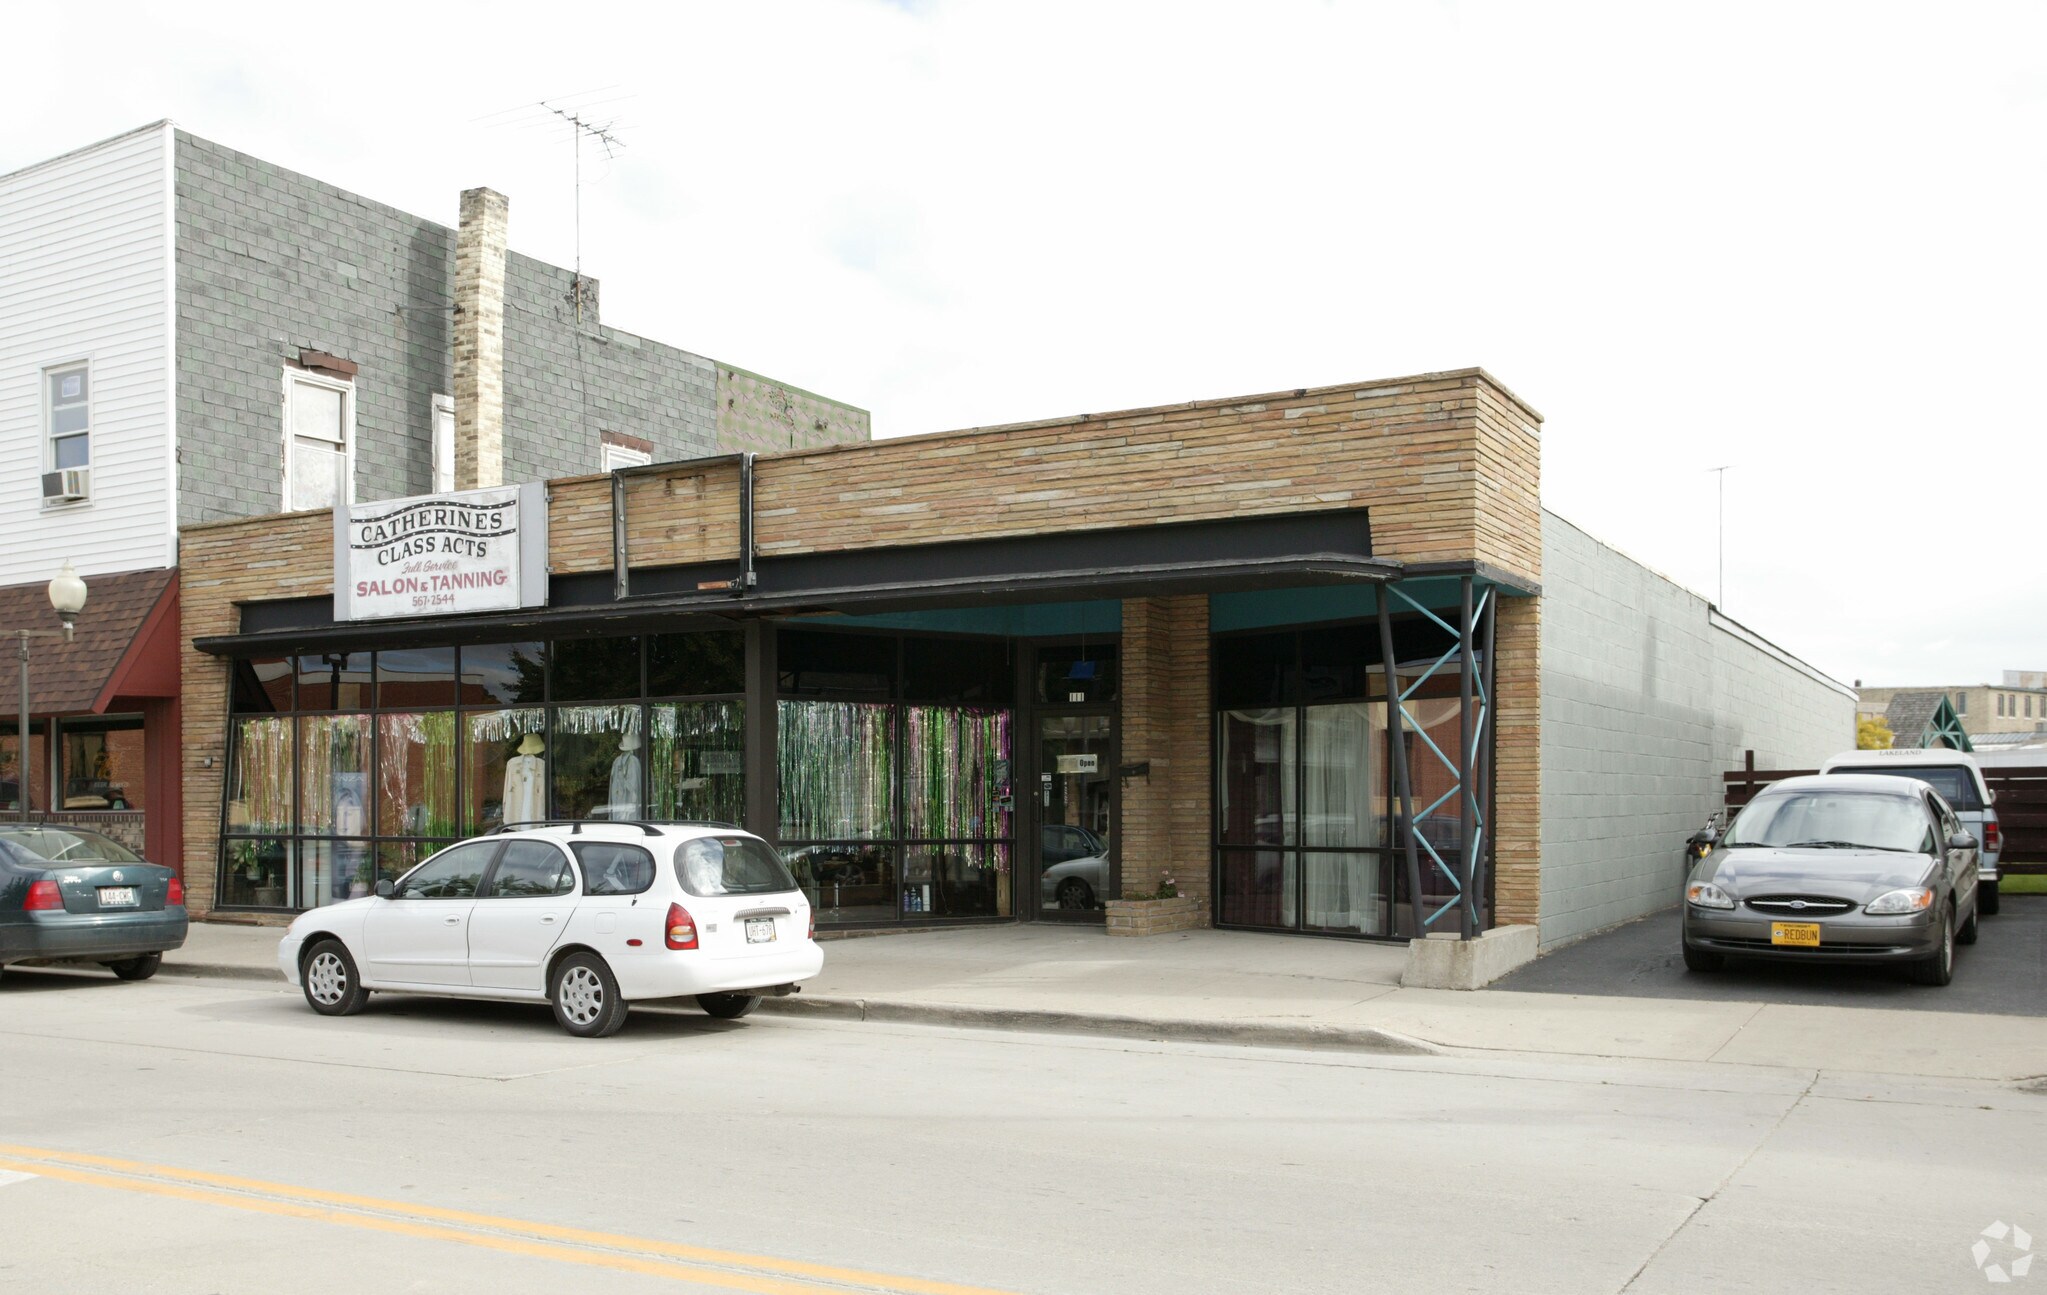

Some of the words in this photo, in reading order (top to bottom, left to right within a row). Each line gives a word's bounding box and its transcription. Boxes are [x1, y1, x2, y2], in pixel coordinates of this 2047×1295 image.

[361, 508, 503, 543] CATHERINES
[377, 536, 436, 566] CLASS
[441, 536, 487, 558] ACTS
[401, 560, 422, 575] Full
[423, 560, 458, 573] Service
[356, 577, 419, 598] SALON
[420, 581, 429, 592] &
[430, 569, 508, 592] TANNING
[1079, 759, 1095, 768] Open
[1784, 928, 1818, 941] REDBUN
